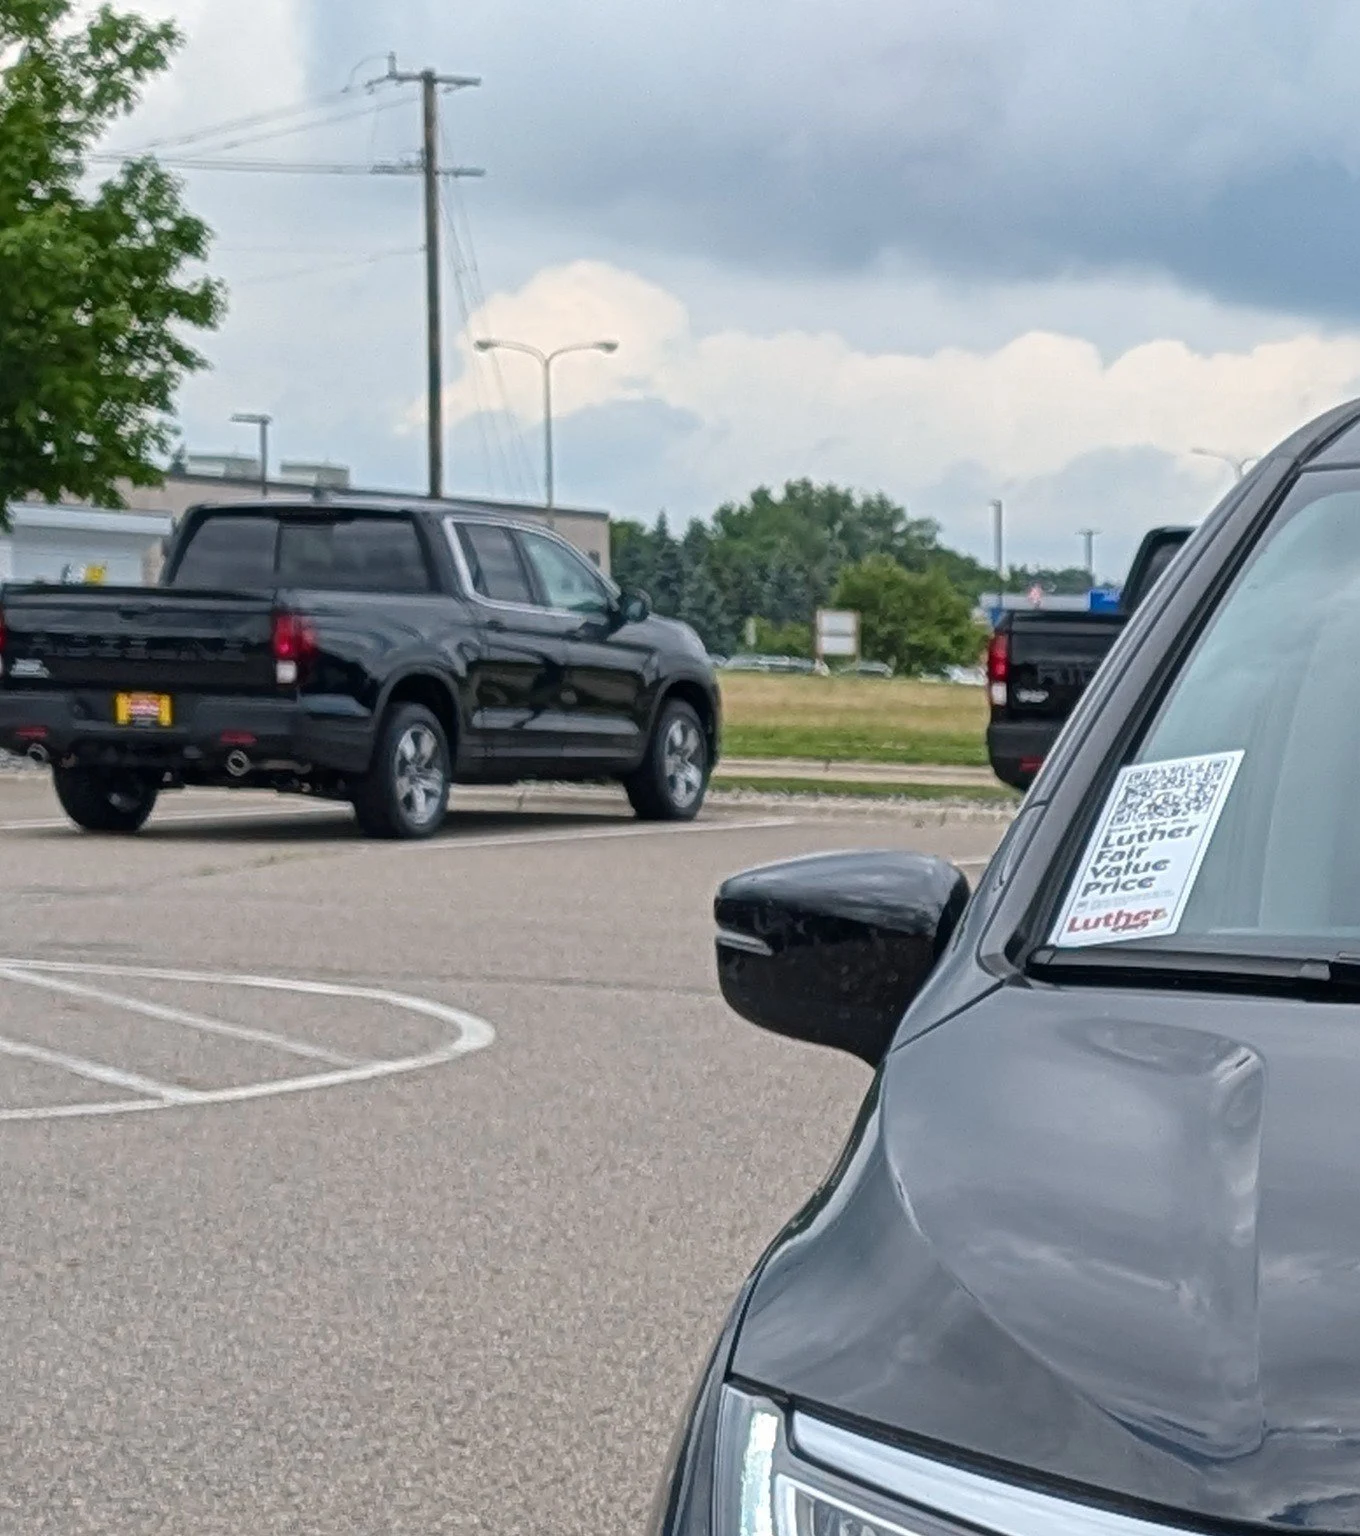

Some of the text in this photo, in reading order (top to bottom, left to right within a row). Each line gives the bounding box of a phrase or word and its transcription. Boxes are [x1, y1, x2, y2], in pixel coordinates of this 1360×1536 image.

[1101, 825, 1199, 848] Luther
[1096, 845, 1149, 865] Fair
[1091, 859, 1170, 878] Value
[1081, 877, 1156, 897] Price
[1067, 909, 1167, 933] Luther
